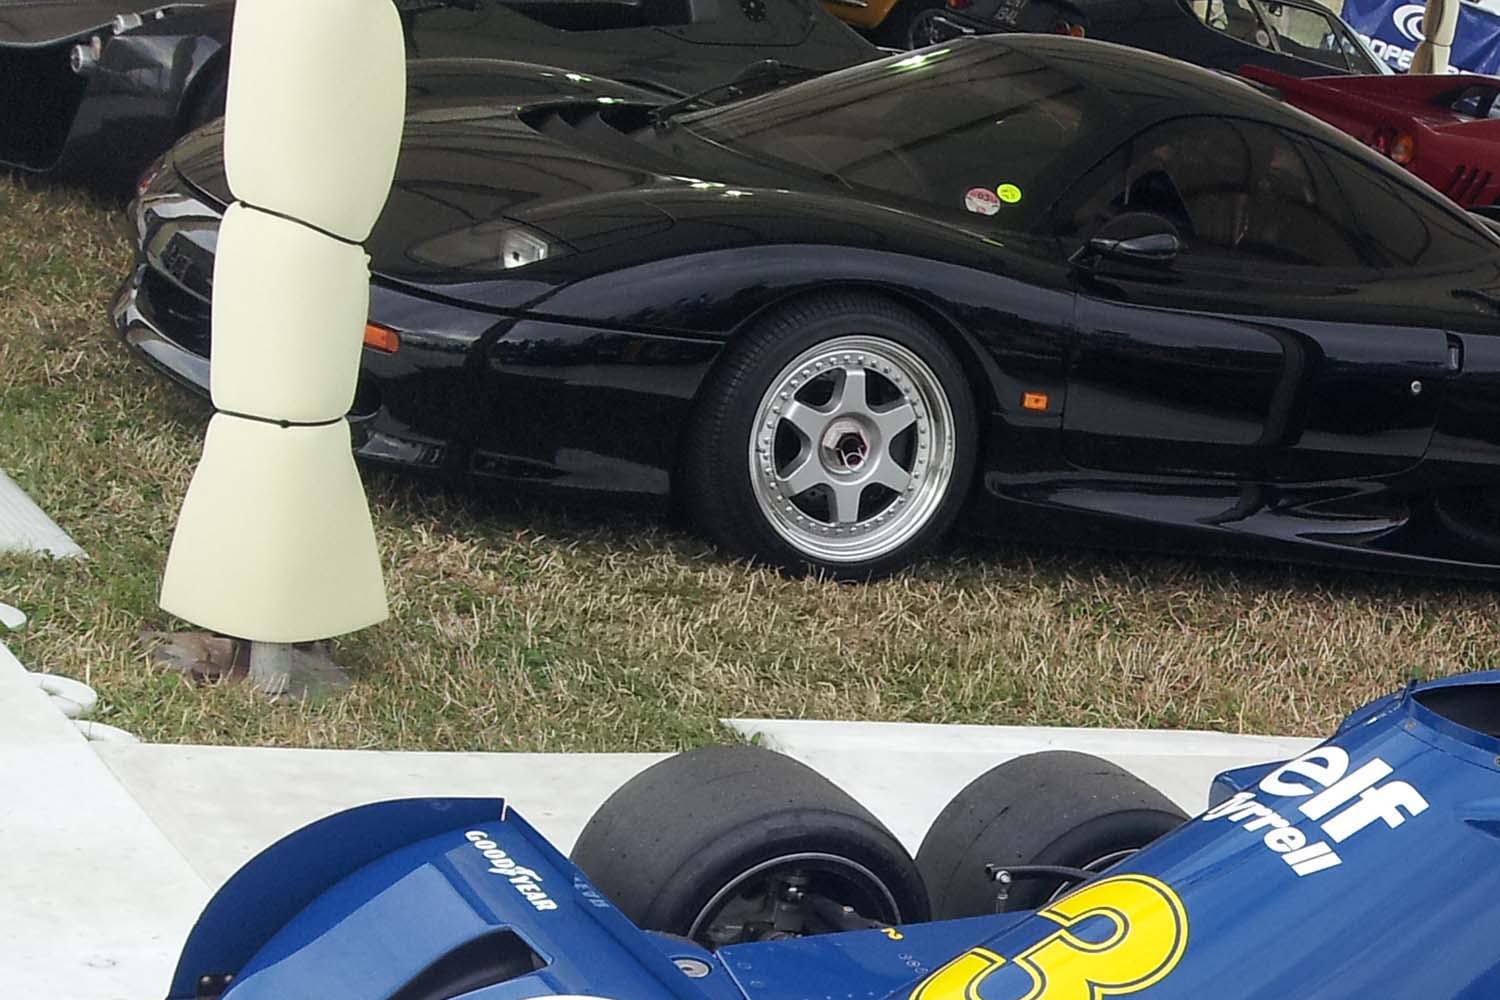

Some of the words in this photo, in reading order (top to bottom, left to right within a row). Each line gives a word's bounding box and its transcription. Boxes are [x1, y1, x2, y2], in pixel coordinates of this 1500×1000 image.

[1201, 791, 1343, 877] yrrell
[1258, 745, 1431, 844] elf
[464, 830, 559, 911] GOODYEAR
